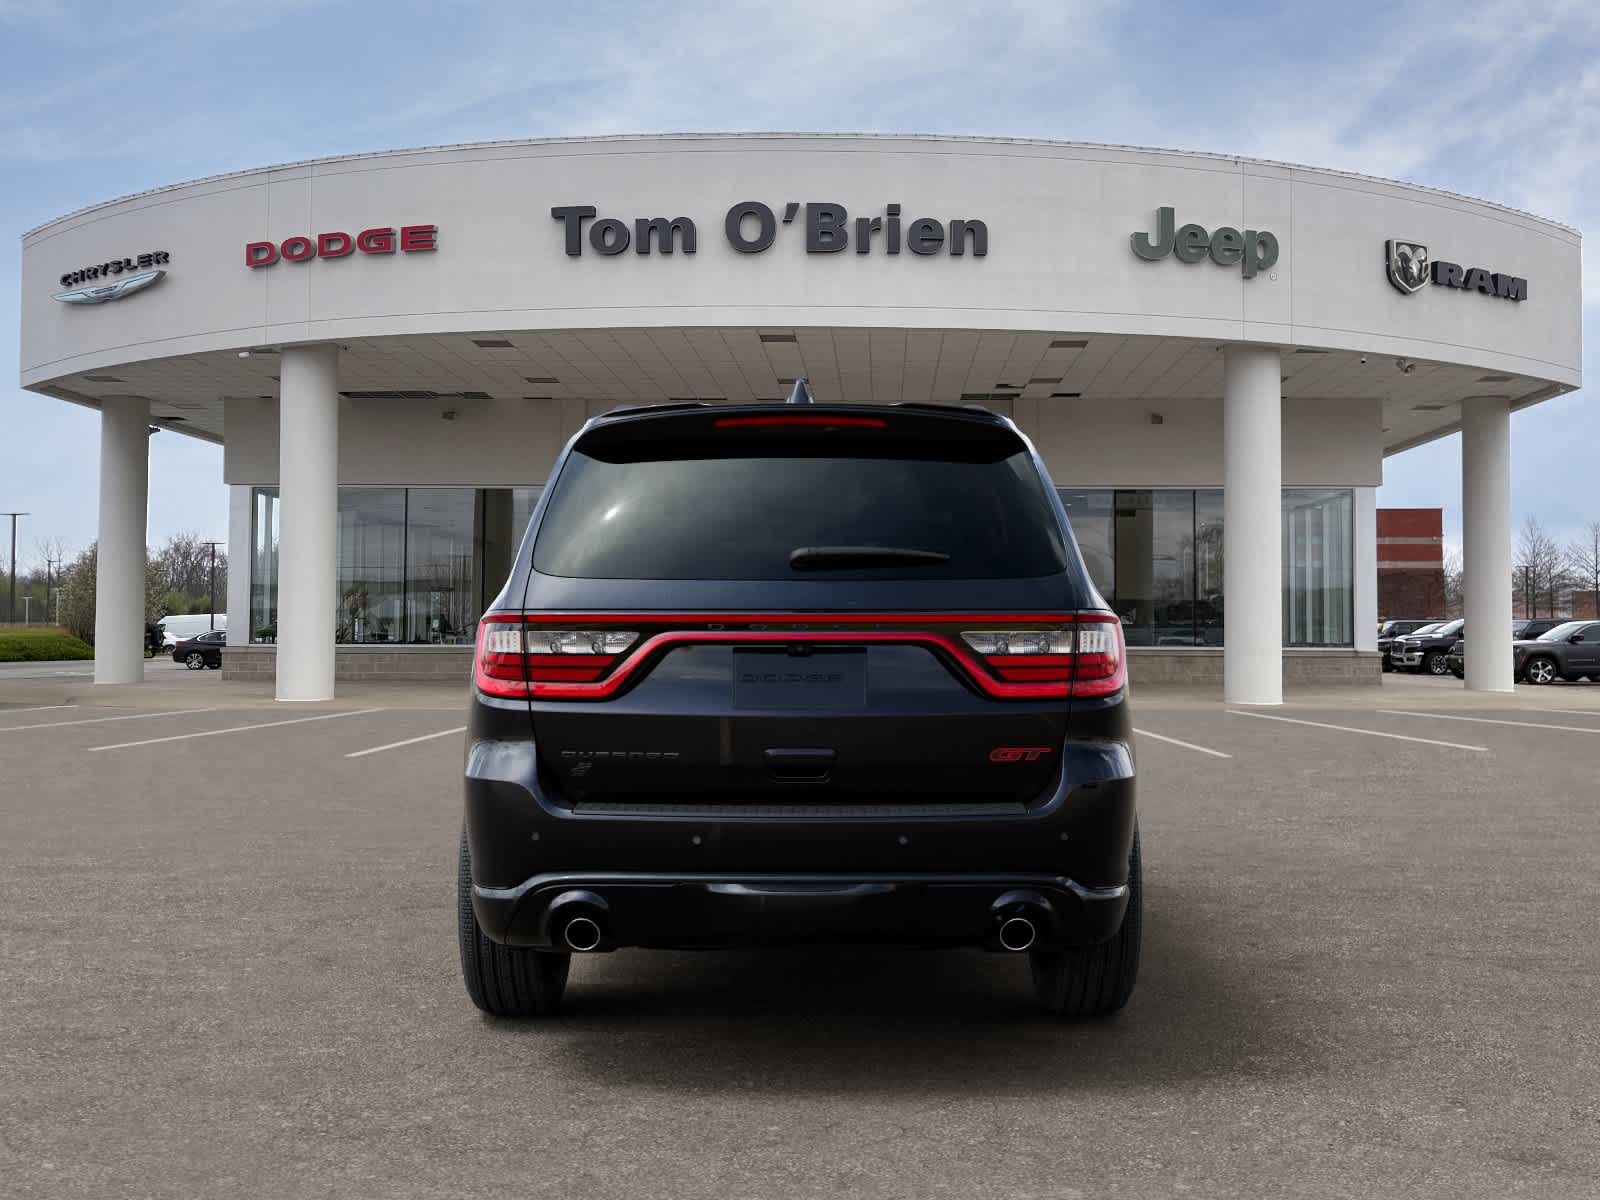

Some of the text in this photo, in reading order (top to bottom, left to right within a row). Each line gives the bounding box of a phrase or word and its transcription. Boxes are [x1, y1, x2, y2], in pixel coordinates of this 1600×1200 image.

[245, 224, 438, 268] DODGE
[550, 205, 697, 257] Tom
[1130, 206, 1279, 279] Jeep
[60, 250, 170, 287] CHRYSLER
[1430, 260, 1528, 302] RAM
[989, 747, 1052, 762] GT
